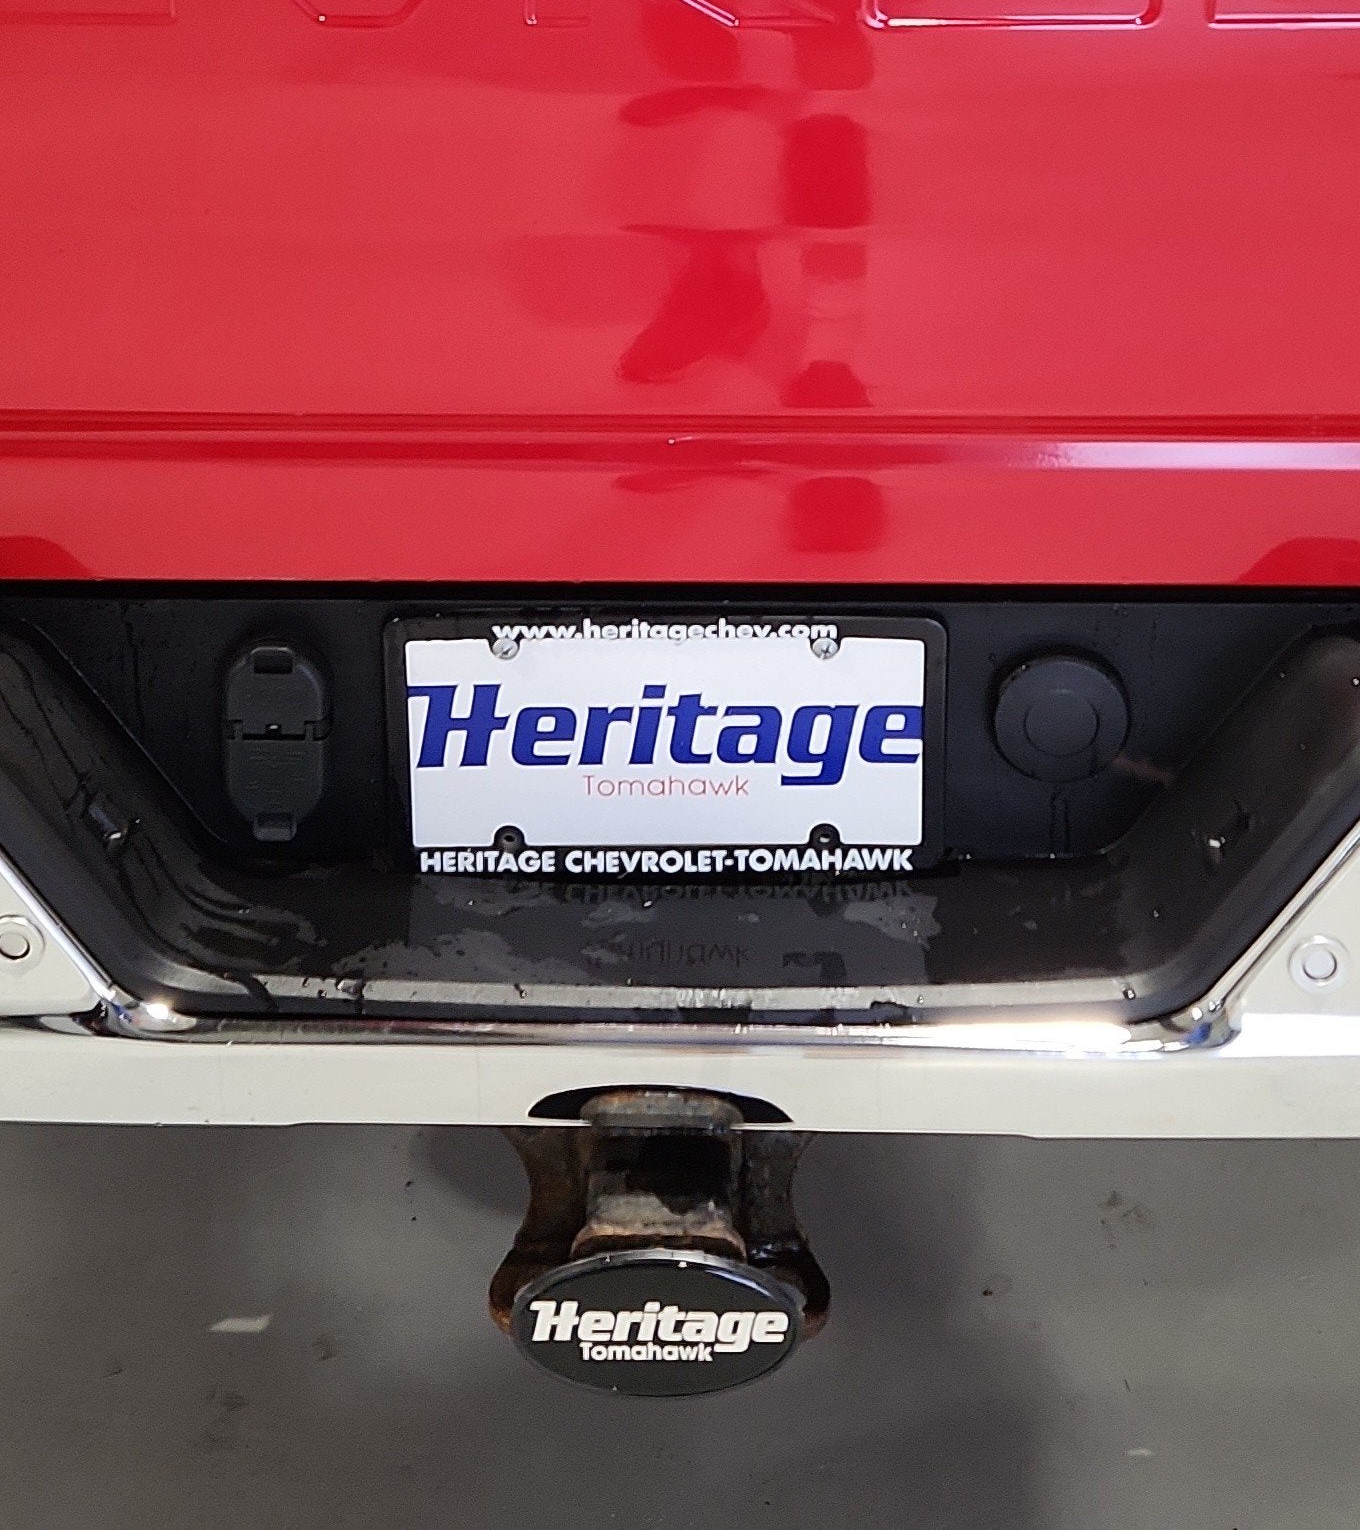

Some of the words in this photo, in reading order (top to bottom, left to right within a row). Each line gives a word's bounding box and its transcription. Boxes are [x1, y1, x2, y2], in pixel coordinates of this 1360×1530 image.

[491, 618, 838, 640] www.heritagechev.com
[406, 683, 924, 786] Heritage
[582, 774, 750, 797] Tomahawk
[420, 850, 556, 873] HERITAGE
[564, 848, 914, 873] CHEVROLET-TOMAHAWK
[529, 1300, 789, 1353] Heritage
[579, 1341, 714, 1362] Tomahawk
